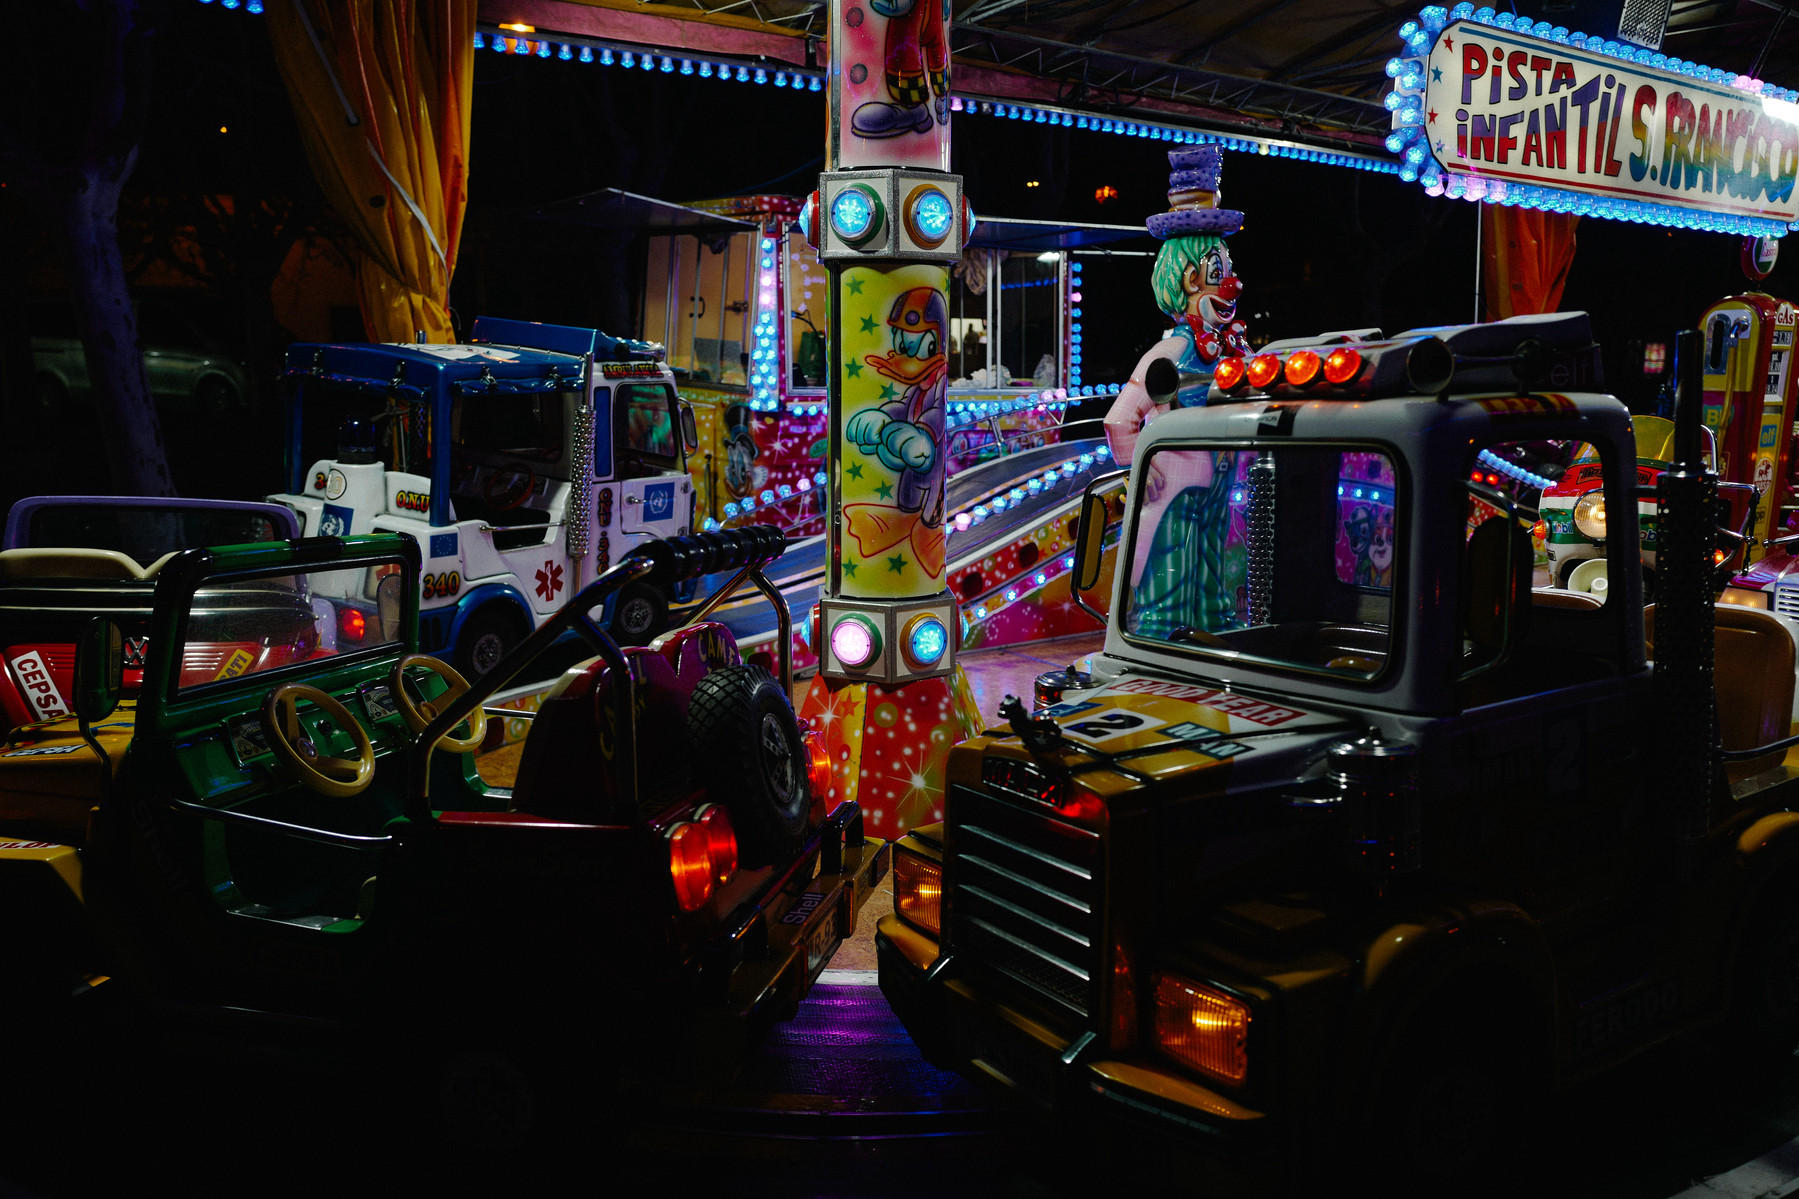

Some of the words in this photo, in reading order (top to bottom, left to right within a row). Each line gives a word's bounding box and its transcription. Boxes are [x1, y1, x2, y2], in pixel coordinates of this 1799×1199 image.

[1777, 307, 1794, 325] GAS
[1551, 355, 1589, 387] elf
[1762, 427, 1775, 444] elf
[423, 570, 461, 599] 340
[17, 657, 67, 719] CEPSA
[1115, 680, 1209, 699] GOOD
[1196, 693, 1286, 723] YEAR
[1063, 713, 1144, 738] 2
[783, 892, 825, 924] Shell
